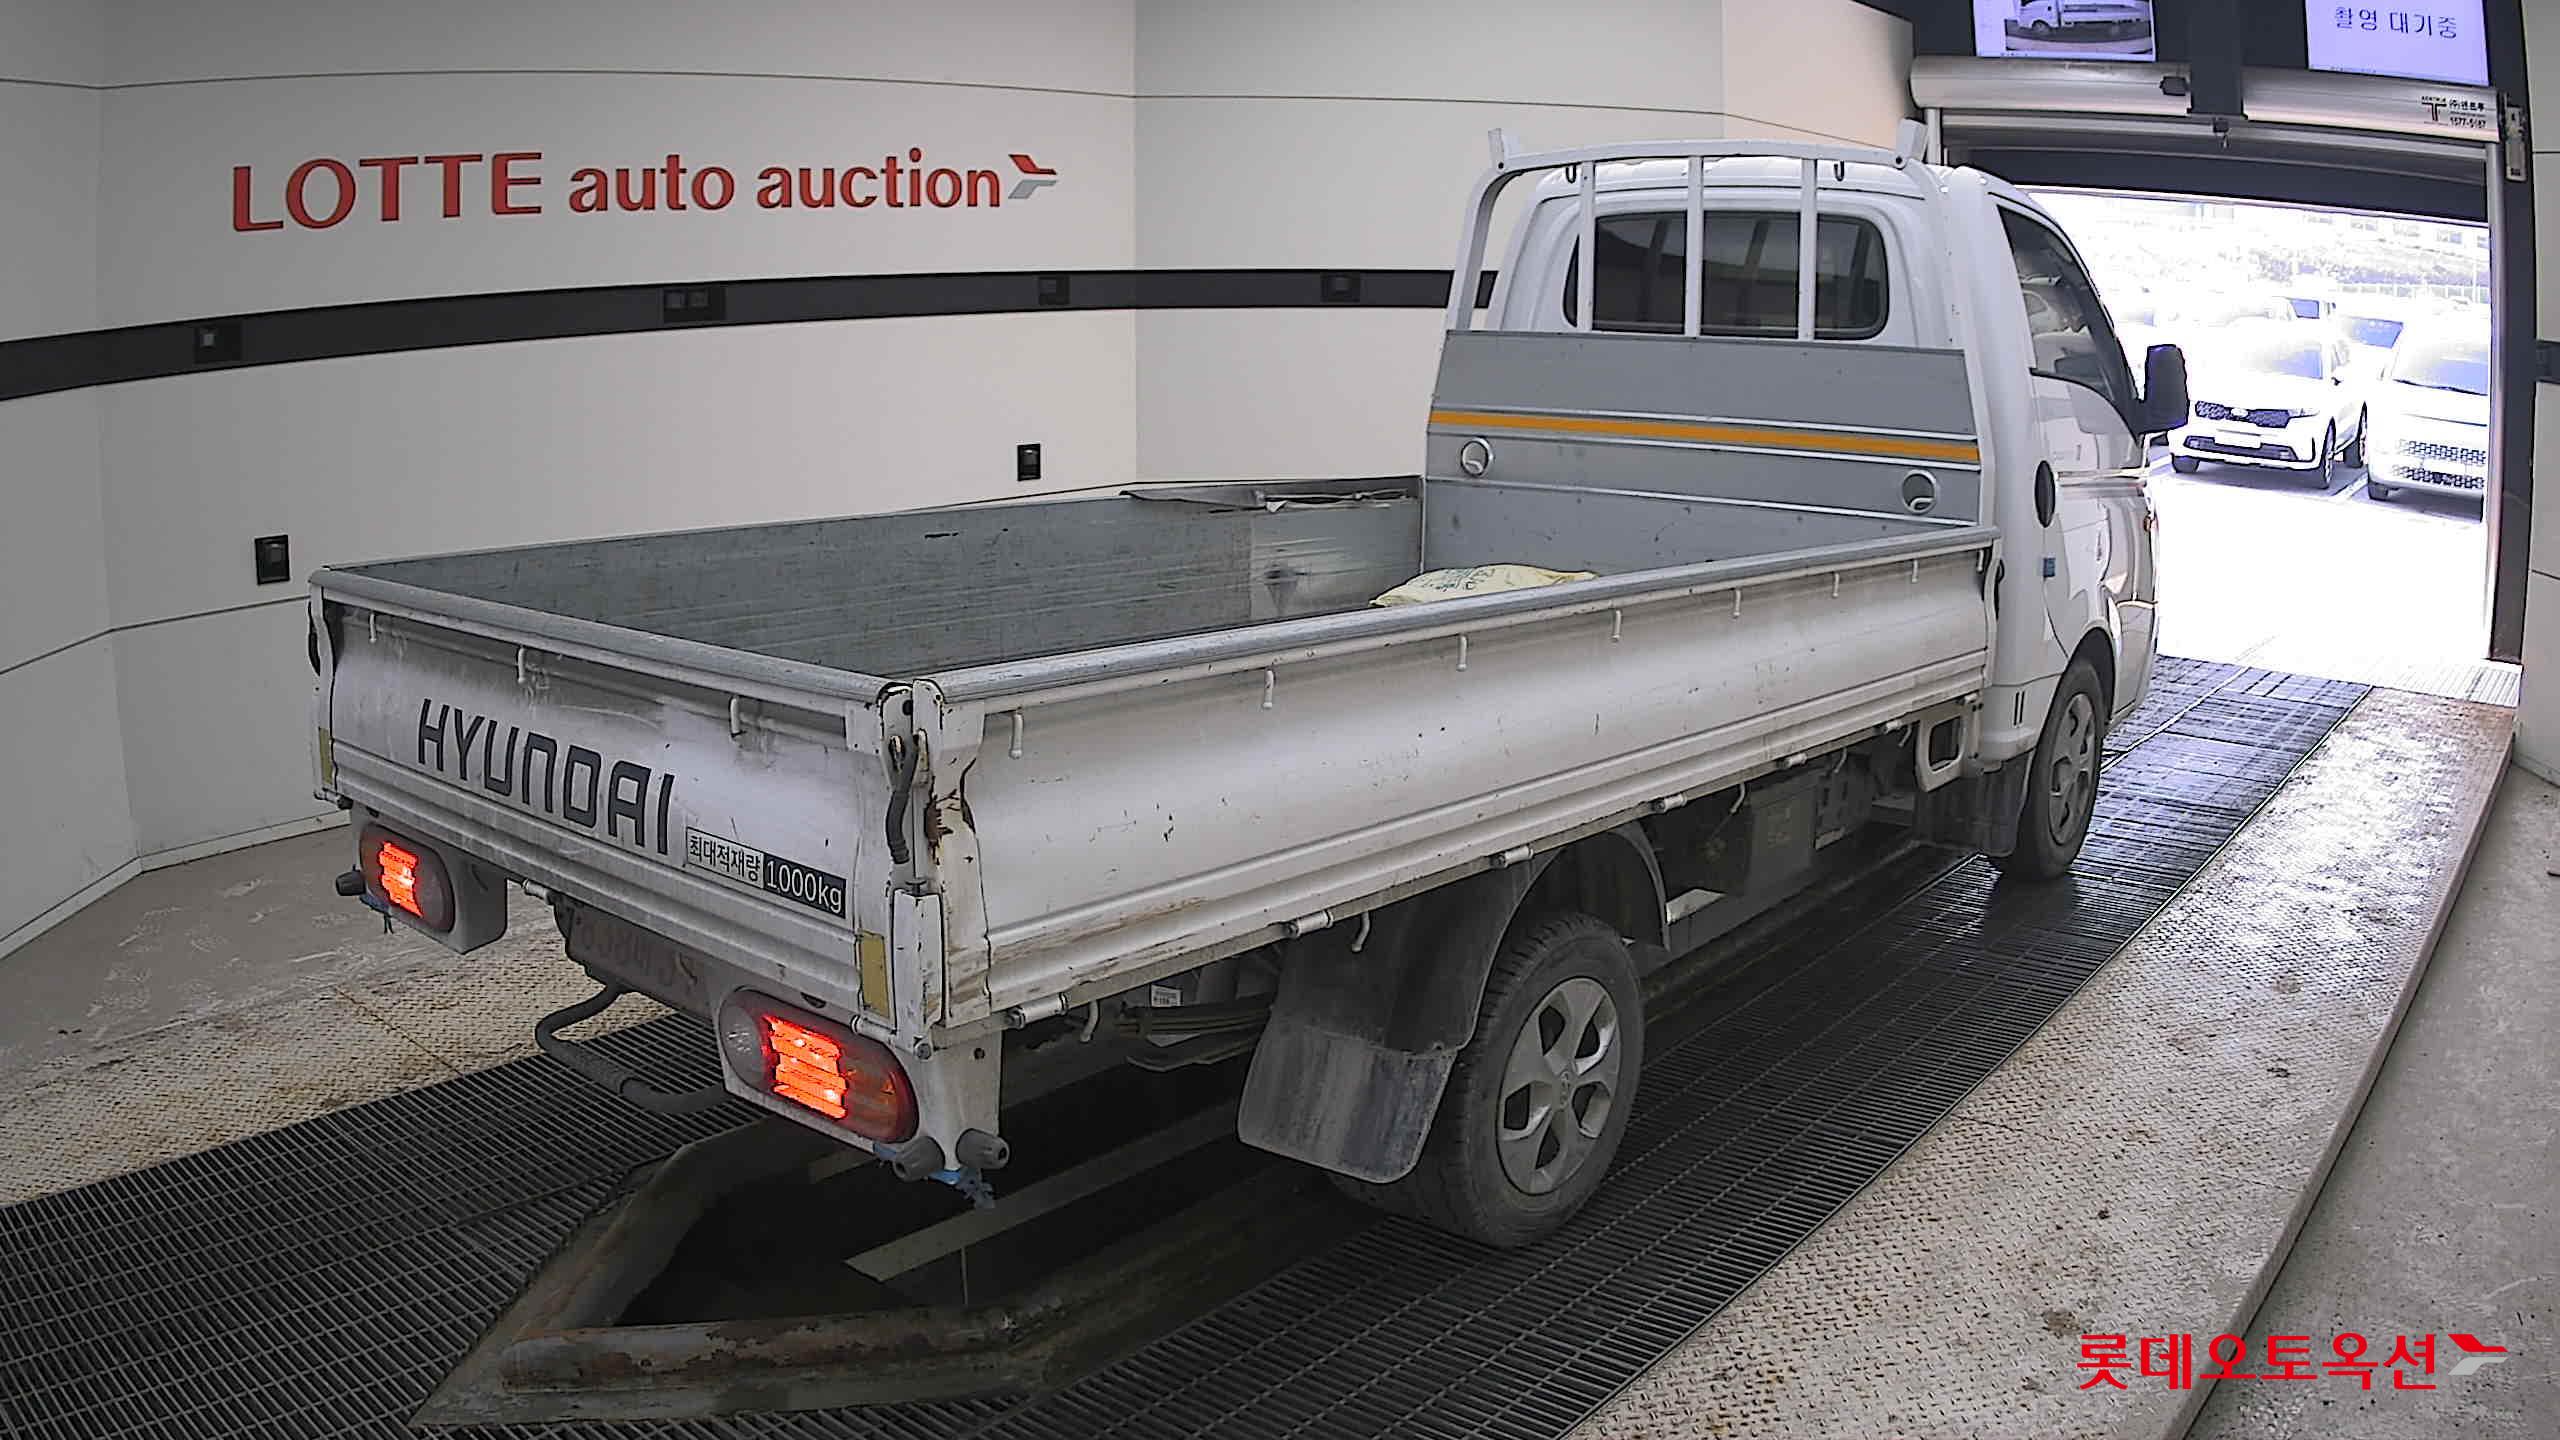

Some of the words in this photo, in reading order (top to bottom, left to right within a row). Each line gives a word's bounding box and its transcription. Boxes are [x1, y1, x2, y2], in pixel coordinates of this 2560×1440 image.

[2335, 7, 2377, 31] 촬영
[2389, 12, 2457, 39] 대기중
[234, 152, 542, 231] LOTTE
[568, 154, 736, 213] auto
[757, 147, 1004, 209] auction
[417, 698, 675, 856] HYUNDAI
[690, 835, 762, 883] 최대적재량
[766, 859, 842, 914] 1000kg
